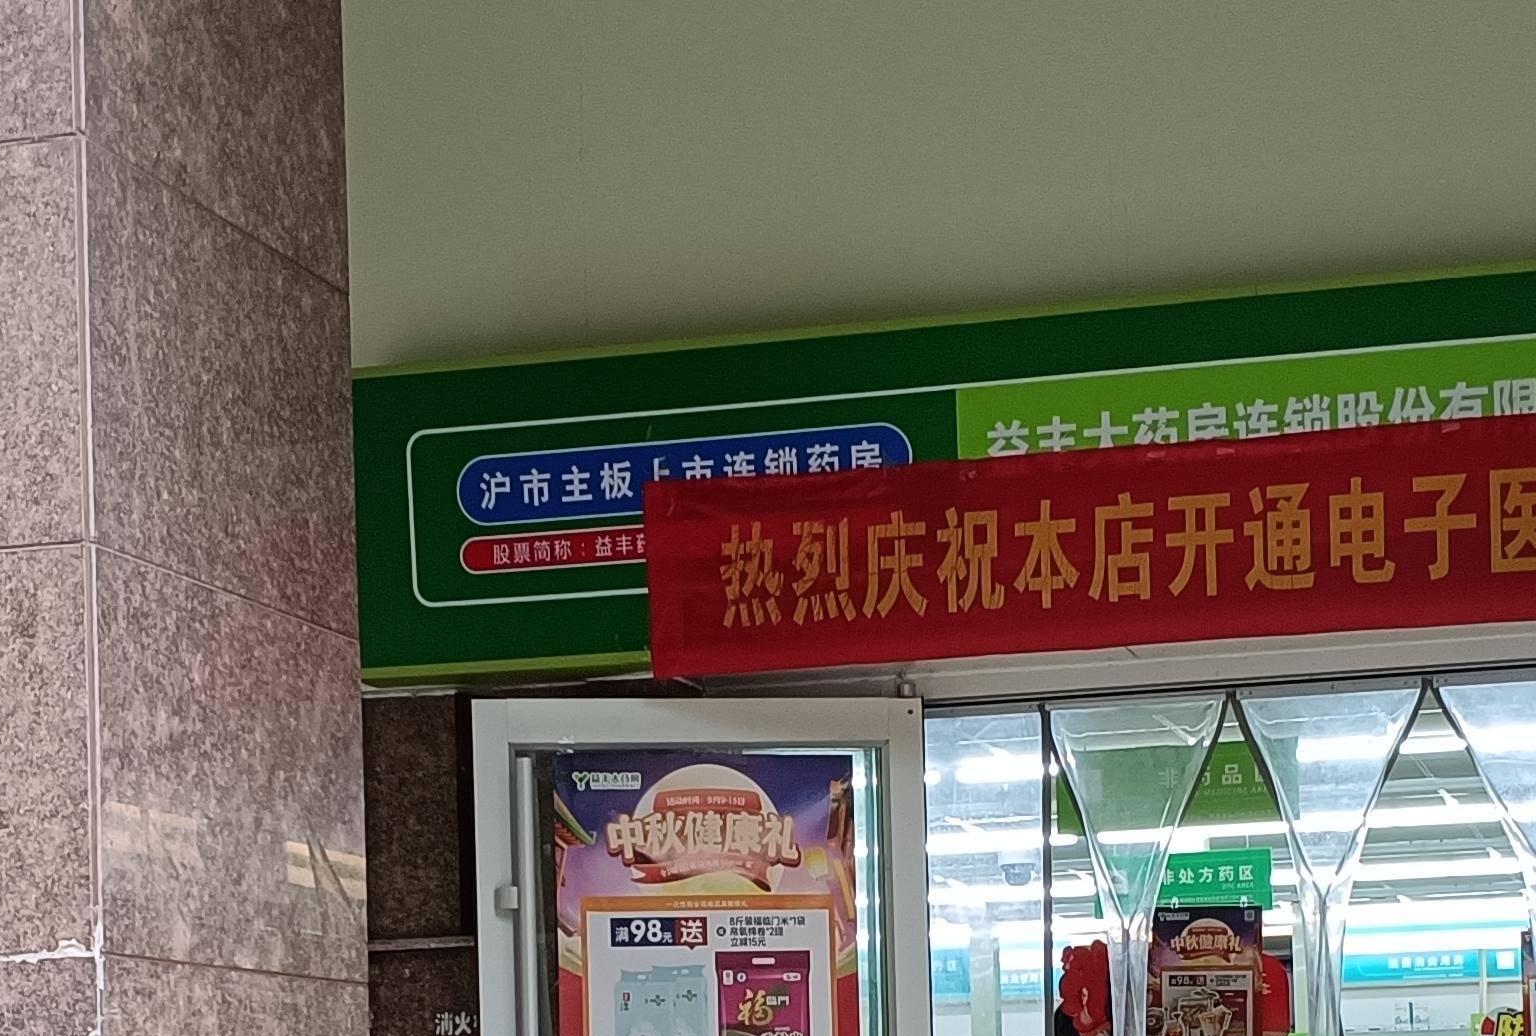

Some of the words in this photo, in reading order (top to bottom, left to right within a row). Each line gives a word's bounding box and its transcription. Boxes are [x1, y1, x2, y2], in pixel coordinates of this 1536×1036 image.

[607, 810, 799, 861] 中秋健康礼
[1163, 865, 1255, 886] 非处方药区
[615, 918, 704, 944] 满98元送
[435, 1011, 477, 1036] 消火
